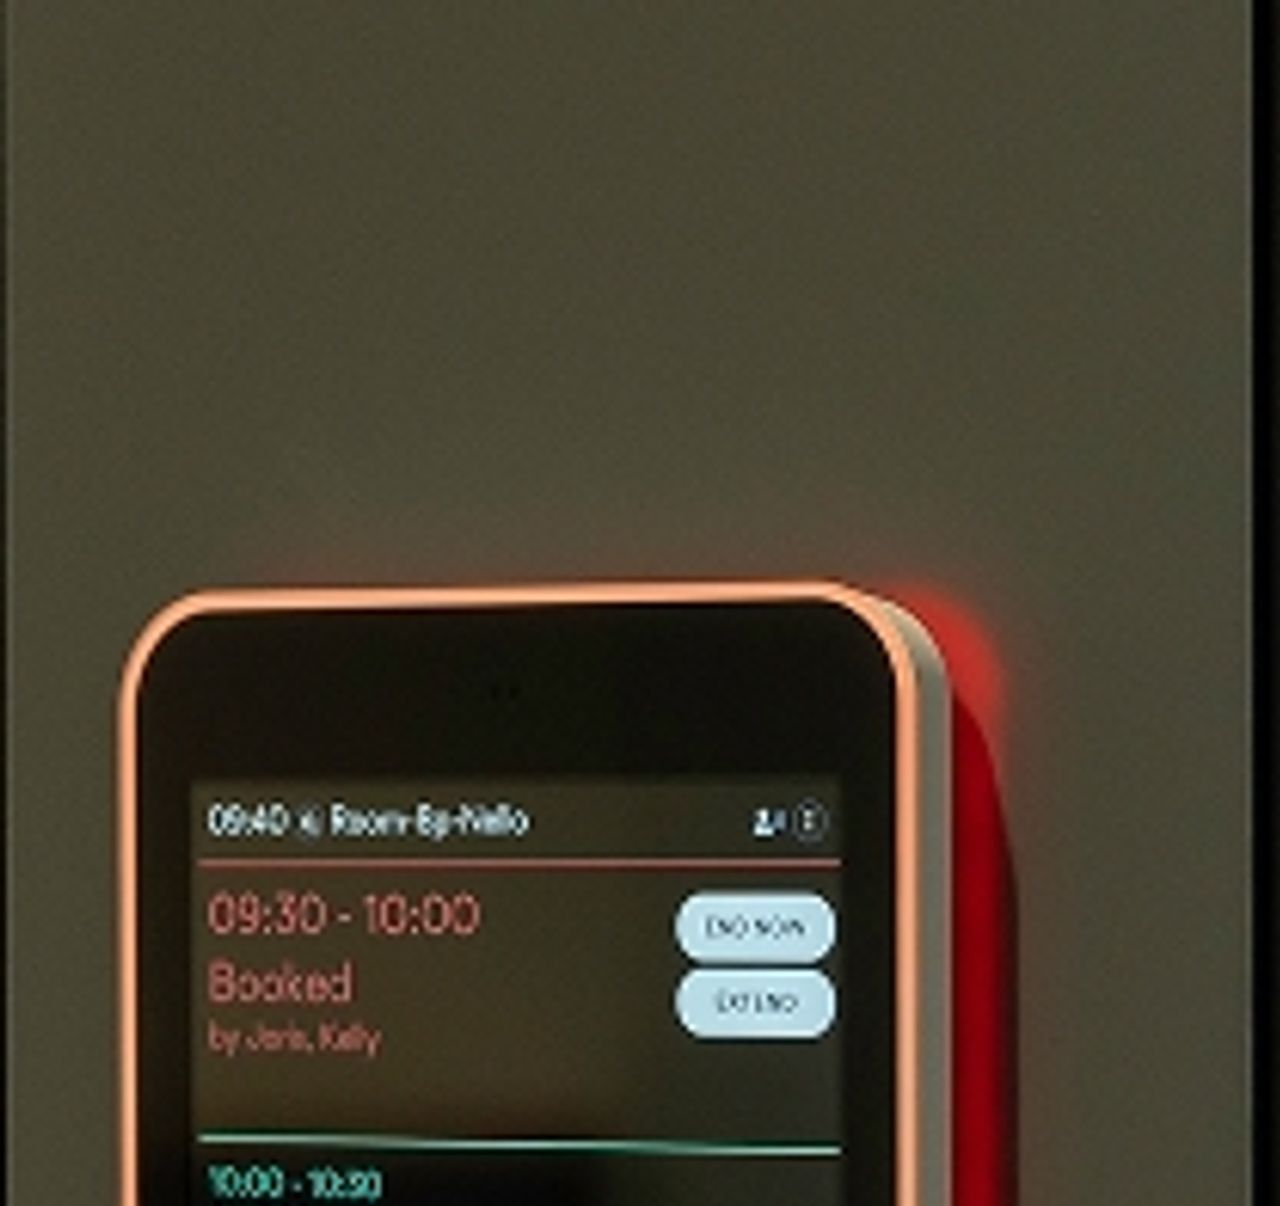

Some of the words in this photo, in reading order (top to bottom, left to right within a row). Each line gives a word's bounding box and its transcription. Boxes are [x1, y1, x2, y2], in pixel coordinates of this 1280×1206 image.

[208, 802, 290, 836] 09:40
[209, 892, 328, 935] 09:30
[362, 892, 481, 935] 10:00
[209, 959, 351, 1002] Booked
[209, 1021, 240, 1057] by
[208, 1165, 285, 1198] 10:00
